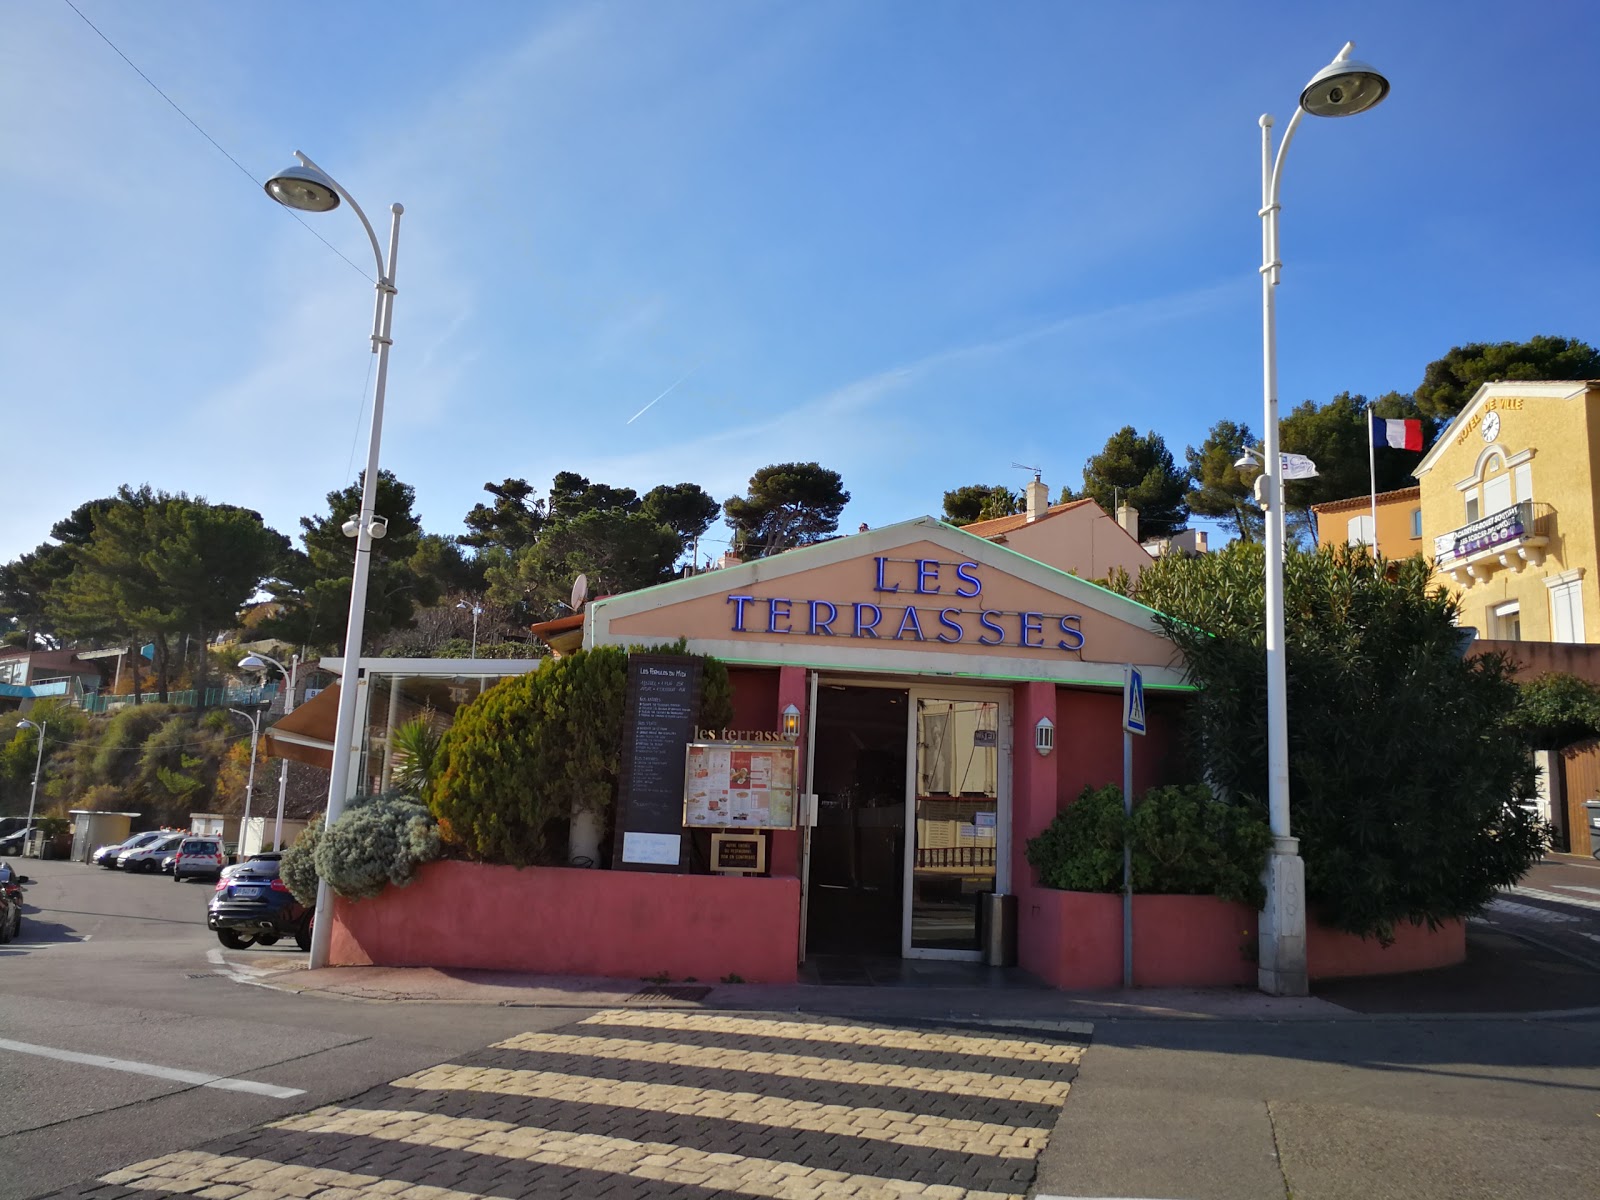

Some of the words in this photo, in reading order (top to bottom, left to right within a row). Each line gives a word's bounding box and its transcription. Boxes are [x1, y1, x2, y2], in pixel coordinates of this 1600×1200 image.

[1484, 399, 1497, 413] DE
[1500, 398, 1524, 411] VILLE
[873, 556, 982, 598] LES
[727, 594, 1086, 651] TERRASSES
[694, 725, 716, 740] les
